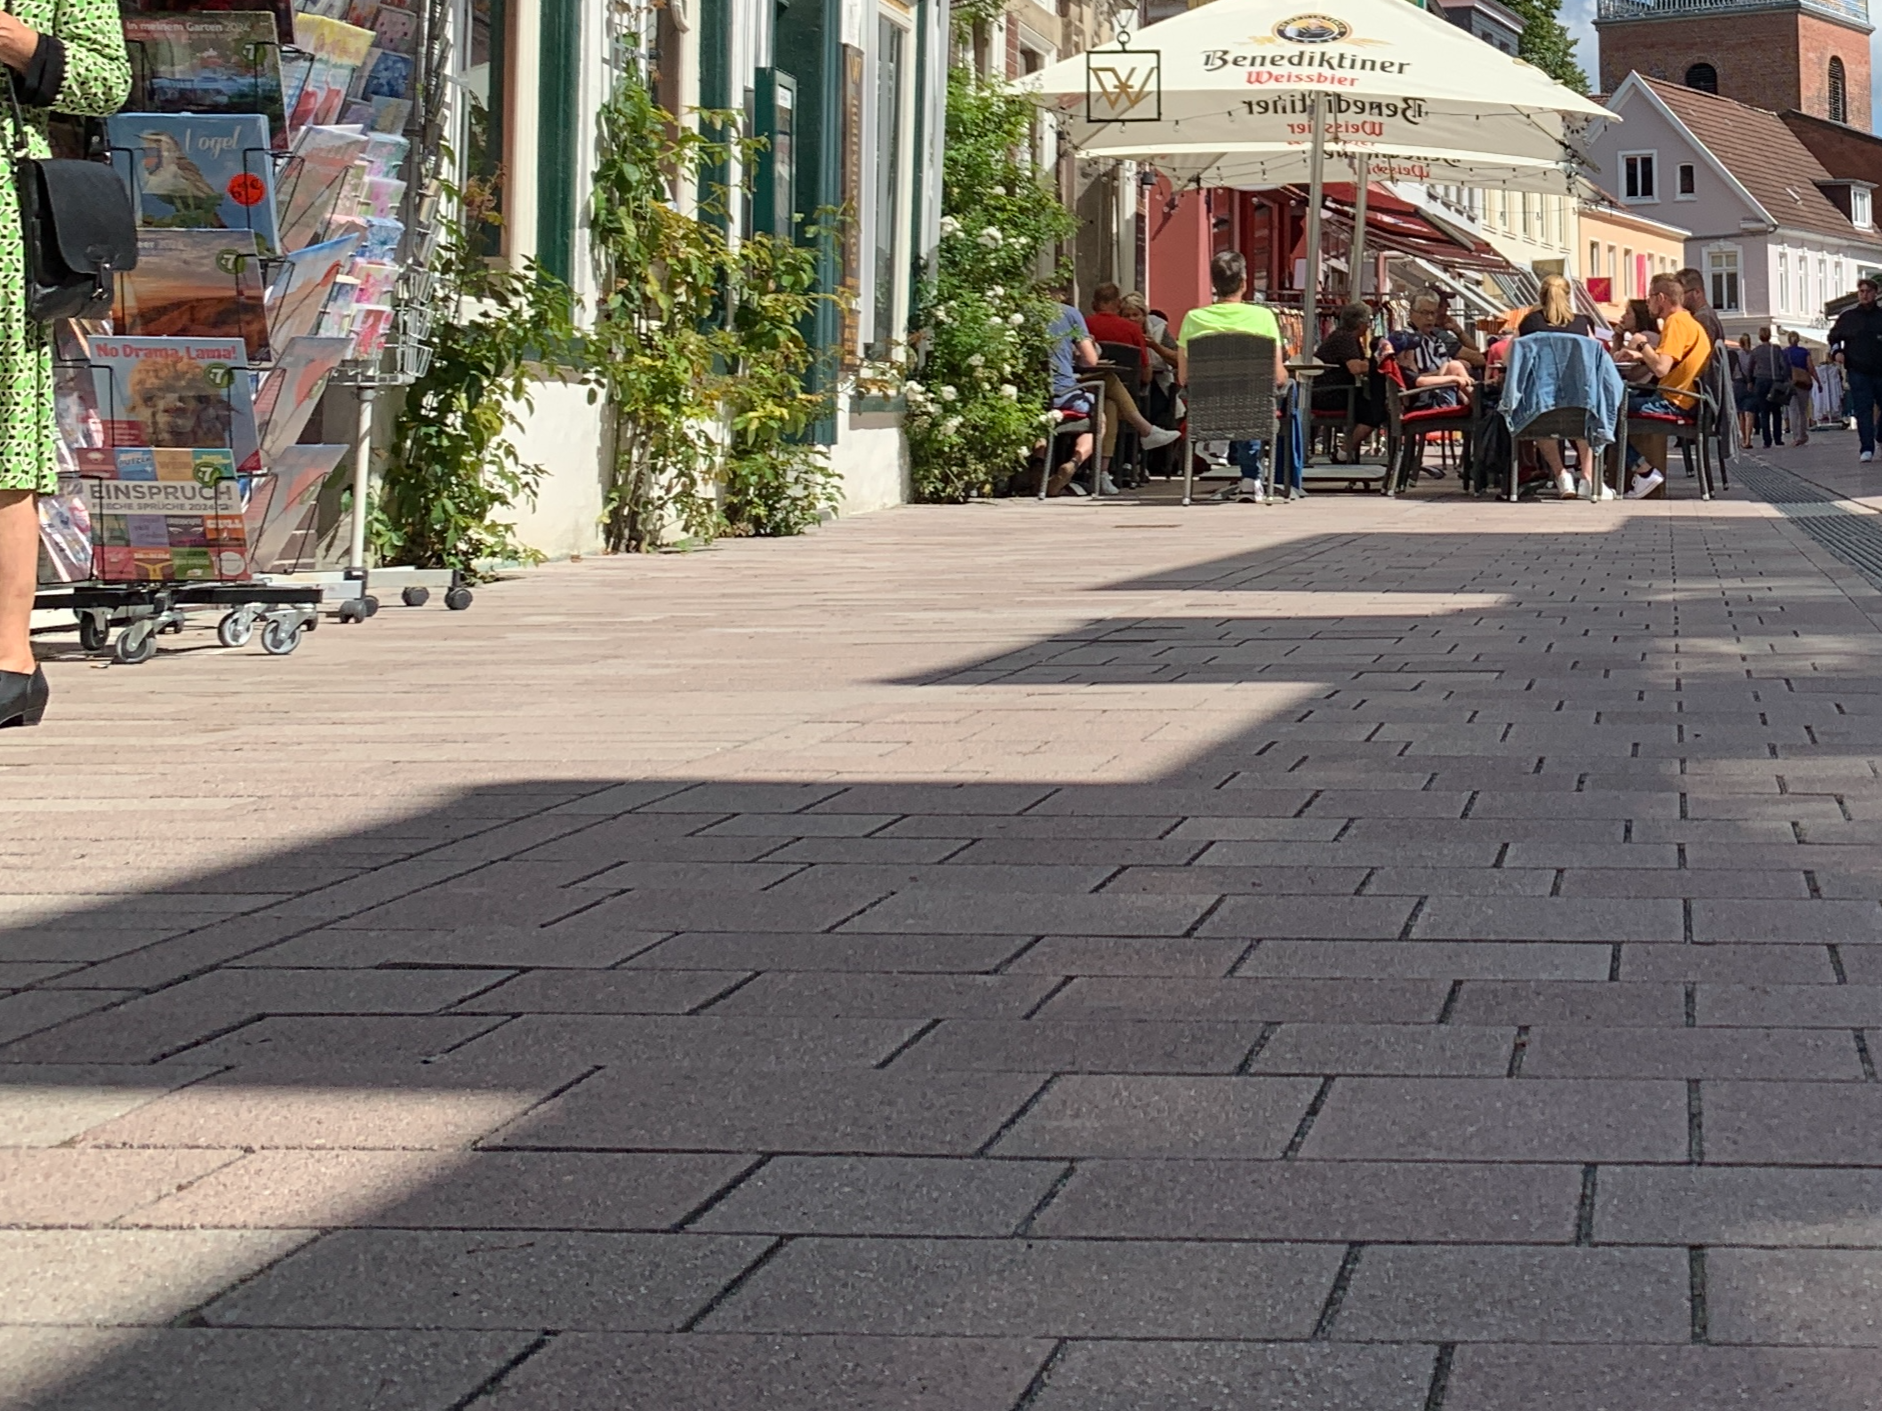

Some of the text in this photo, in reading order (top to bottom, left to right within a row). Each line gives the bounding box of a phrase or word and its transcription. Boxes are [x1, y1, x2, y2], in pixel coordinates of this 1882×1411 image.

[186, 21, 223, 32] Garten
[1201, 48, 1411, 74] Benediktiner
[1246, 70, 1359, 87] Weissbier
[95, 342, 238, 363] No Drama, Lama!
[89, 483, 233, 501] EINSPRUCH
[136, 501, 187, 511] SPRÜCHE
[188, 502, 214, 511] 2024
